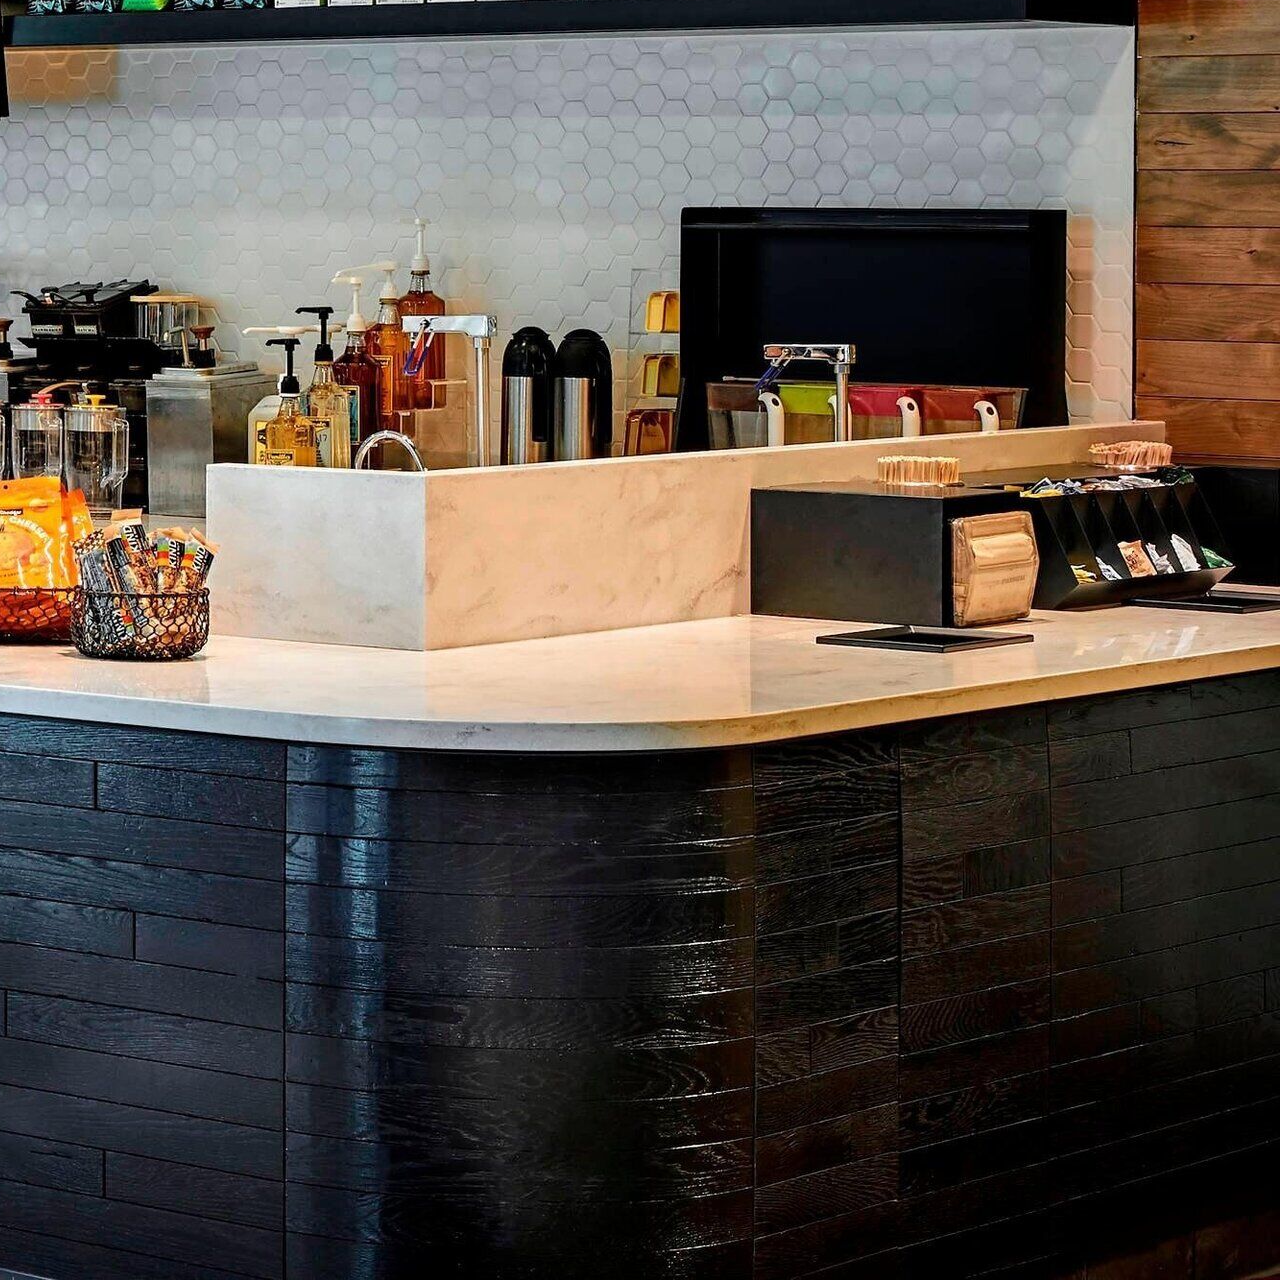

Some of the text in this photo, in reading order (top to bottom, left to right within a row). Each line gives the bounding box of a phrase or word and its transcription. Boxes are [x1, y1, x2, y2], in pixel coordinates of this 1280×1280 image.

[8, 516, 54, 543] CHEESE
[124, 525, 140, 552] KIND
[168, 540, 177, 568] KIND
[191, 546, 206, 572] KIND
